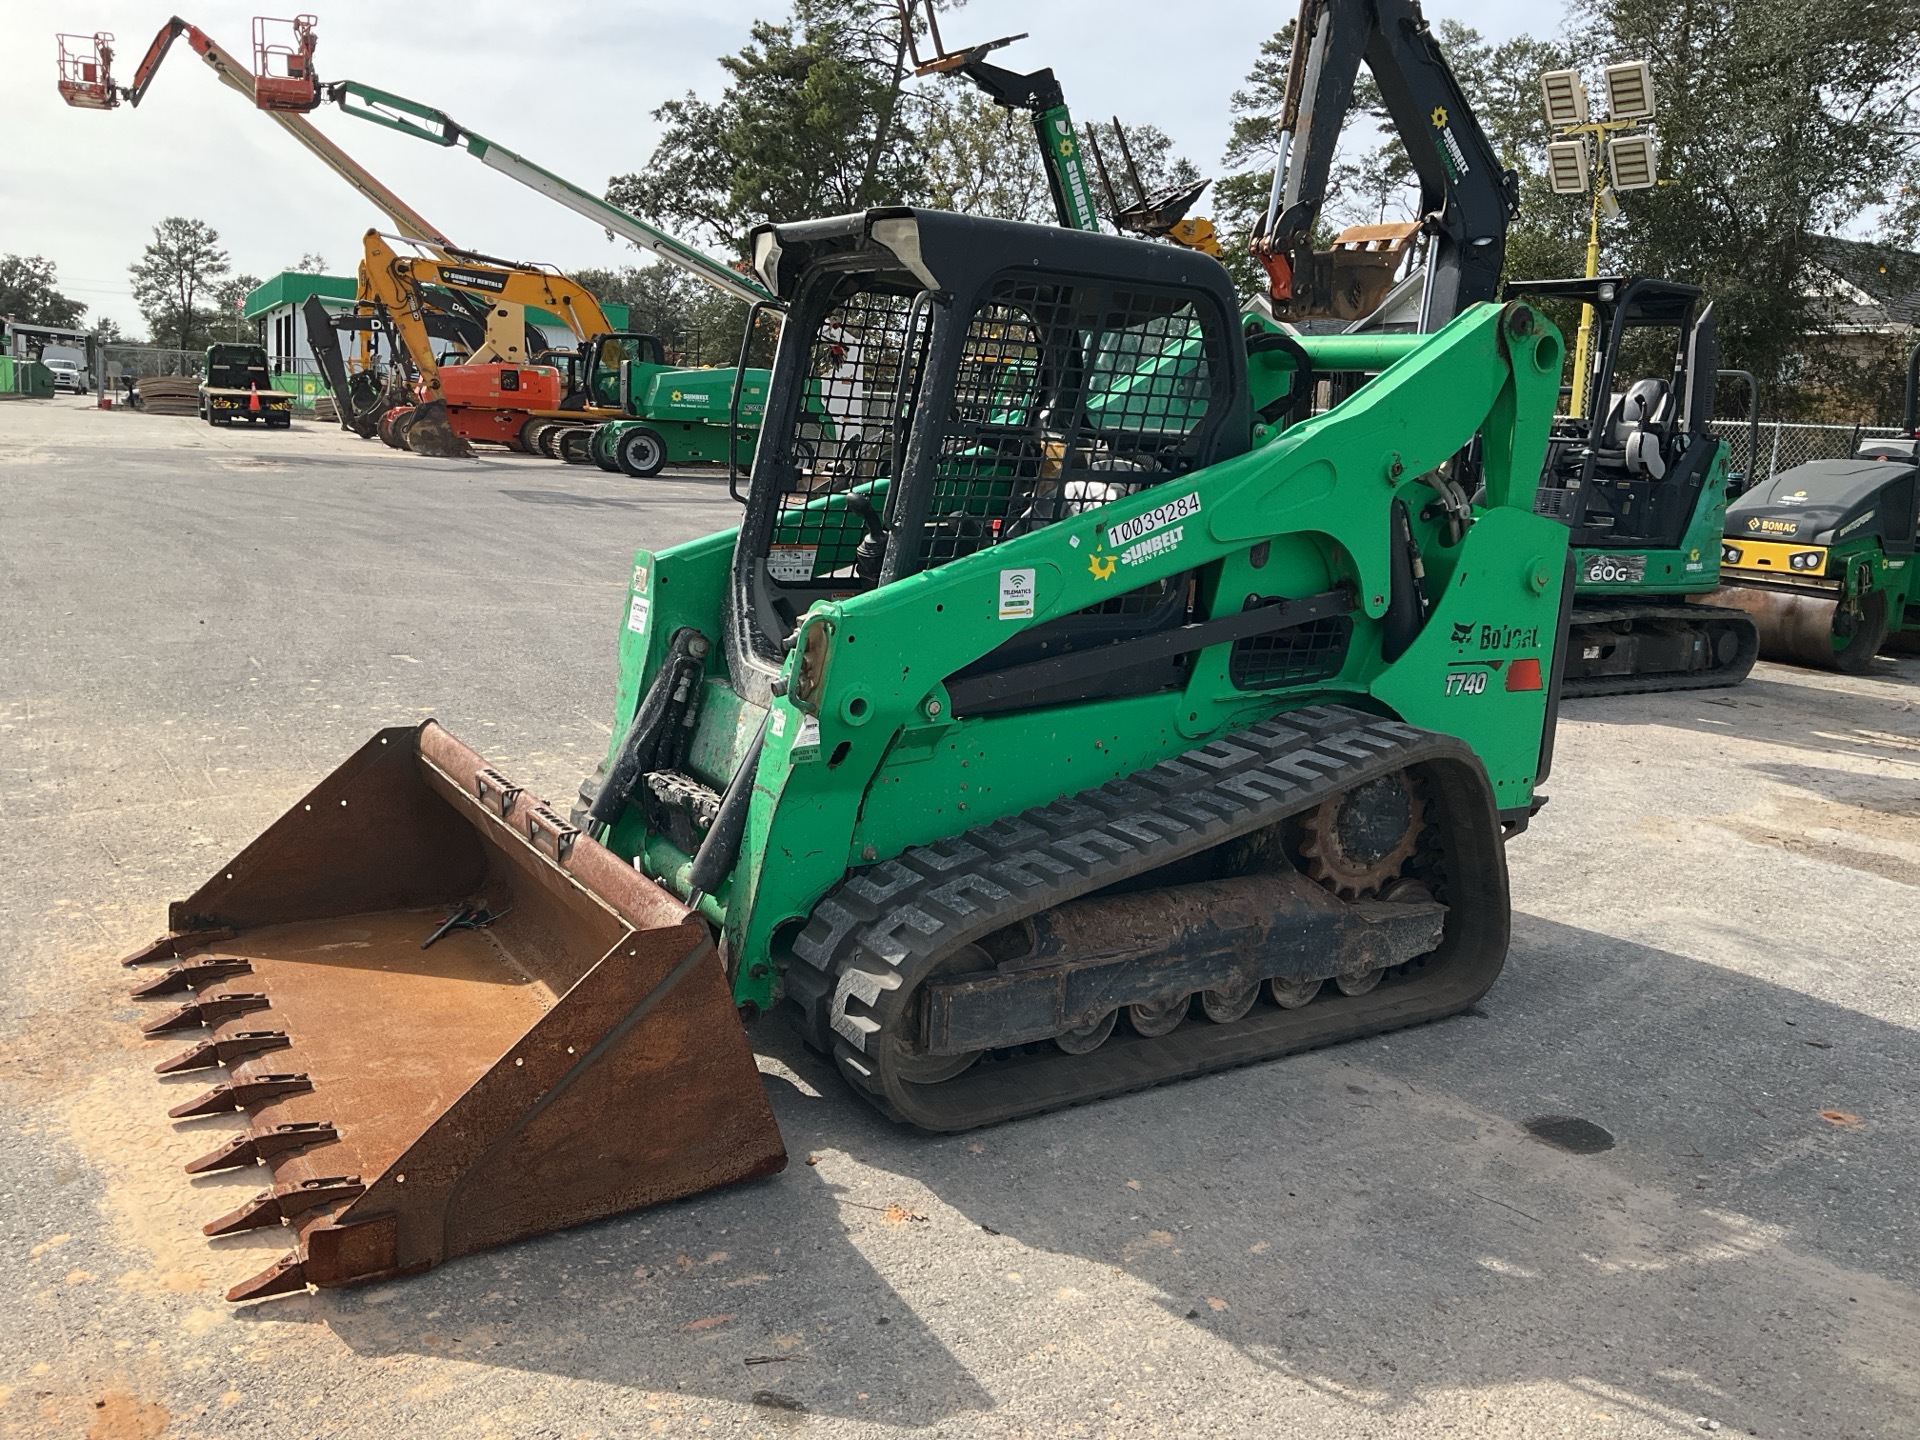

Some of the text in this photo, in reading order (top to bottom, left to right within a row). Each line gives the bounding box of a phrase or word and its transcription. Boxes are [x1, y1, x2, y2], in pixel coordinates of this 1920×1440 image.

[1443, 126, 1470, 176] SUNBELT
[1066, 160, 1093, 231] SUNBELT
[1110, 493, 1199, 545] 10039284
[1761, 520, 1797, 533] BOMAG
[1120, 525, 1184, 565] SUNBELT
[1131, 543, 1177, 567] RENTALS
[1590, 564, 1628, 581] 60G
[1445, 672, 1488, 697] T740
